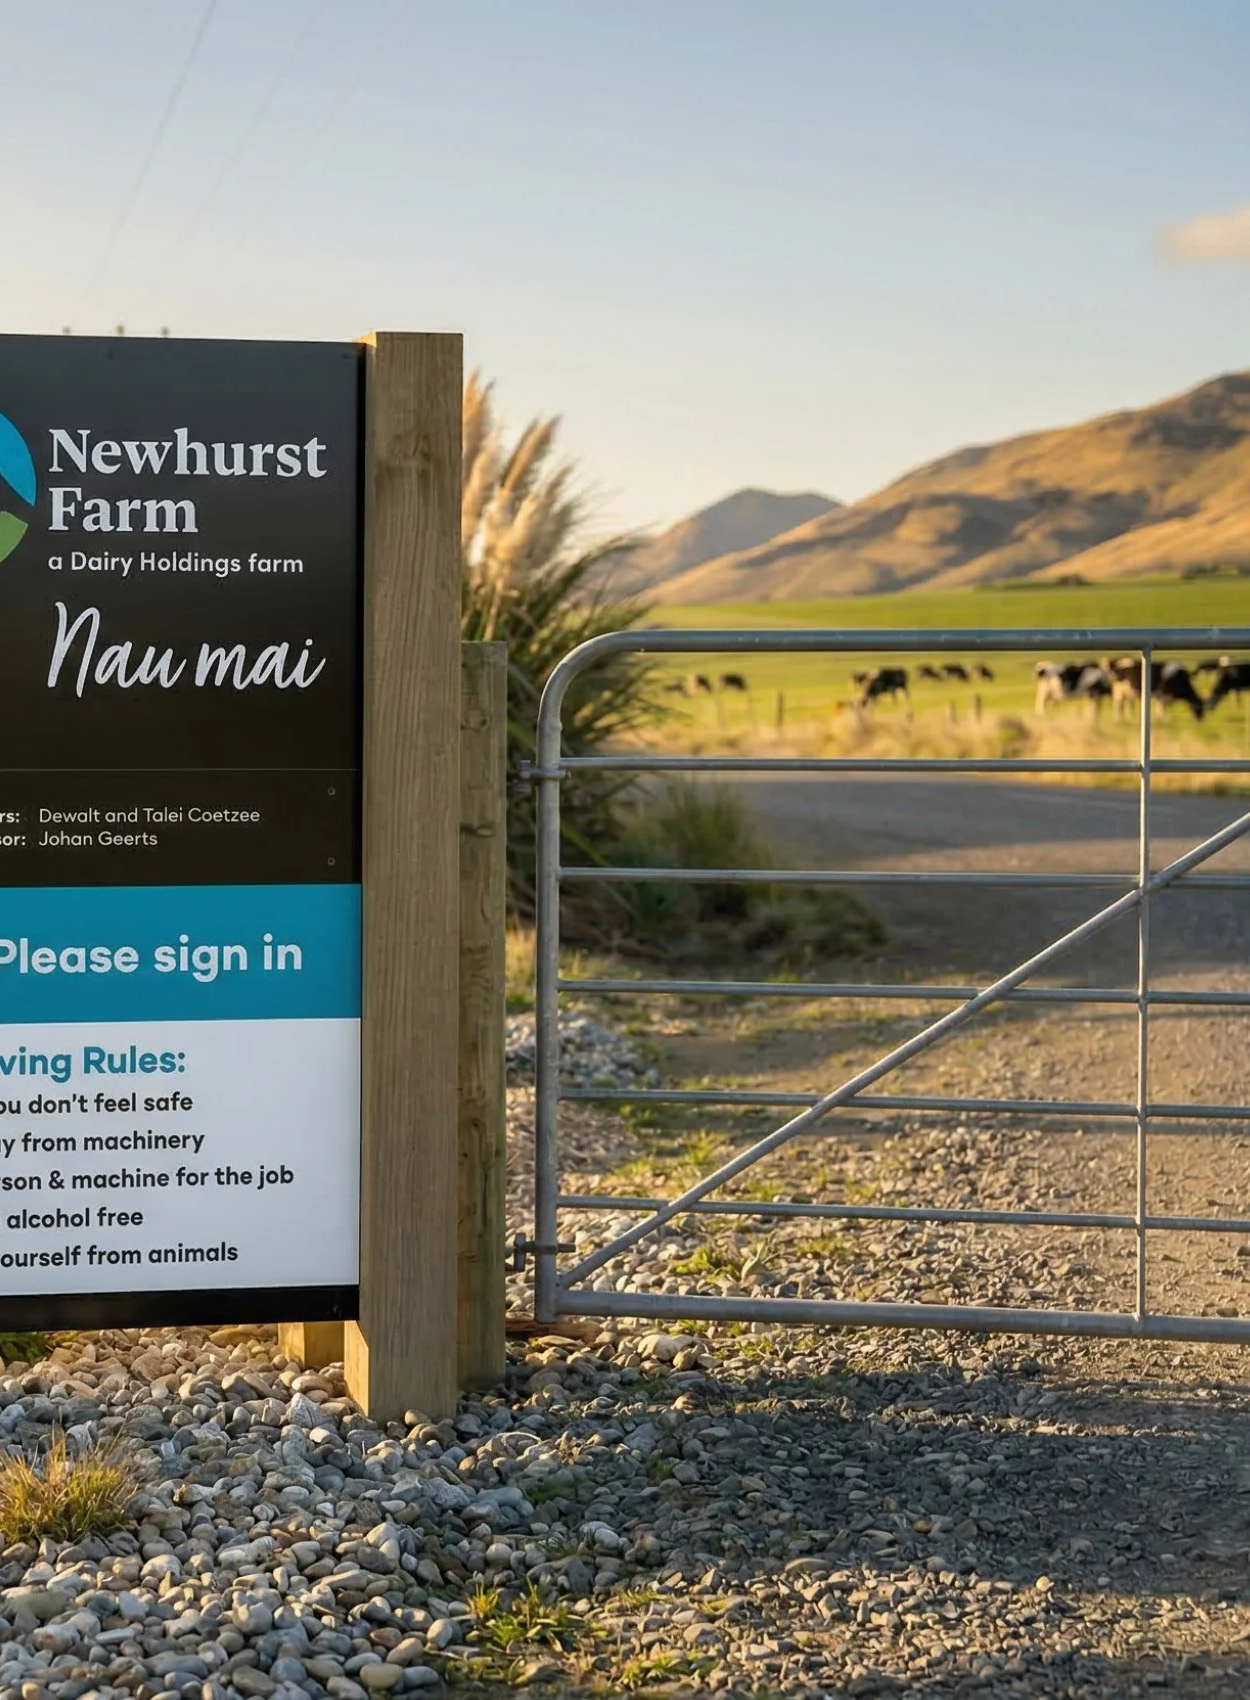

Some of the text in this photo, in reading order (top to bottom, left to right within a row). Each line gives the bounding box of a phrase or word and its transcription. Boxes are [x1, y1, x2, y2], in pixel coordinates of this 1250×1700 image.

[49, 428, 326, 477] Newhurst
[49, 488, 198, 532] Farm
[49, 552, 303, 577] a Dairy Holdings farm
[48, 602, 326, 697] Nau mai
[40, 808, 100, 822] Dewalt
[105, 808, 137, 822] and
[143, 807, 182, 822] Talei
[188, 808, 260, 822] Coetzee
[39, 831, 92, 845] Johan
[98, 831, 157, 845] Geerts
[154, 934, 247, 982] sign
[264, 933, 301, 970] in
[84, 1045, 185, 1074] Rules:
[29, 1094, 88, 1114] don't
[94, 1093, 136, 1112] feel
[144, 1091, 193, 1111] safe
[22, 1132, 76, 1152] from
[84, 1130, 205, 1153] machinery
[49, 1170, 64, 1189] &
[72, 1168, 169, 1189] machine
[176, 1167, 209, 1186] for
[214, 1166, 252, 1185] the
[257, 1165, 293, 1189] job
[7, 1208, 89, 1229] alcohol
[97, 1207, 143, 1226] free
[87, 1245, 141, 1264] from
[149, 1242, 238, 1263] animals
